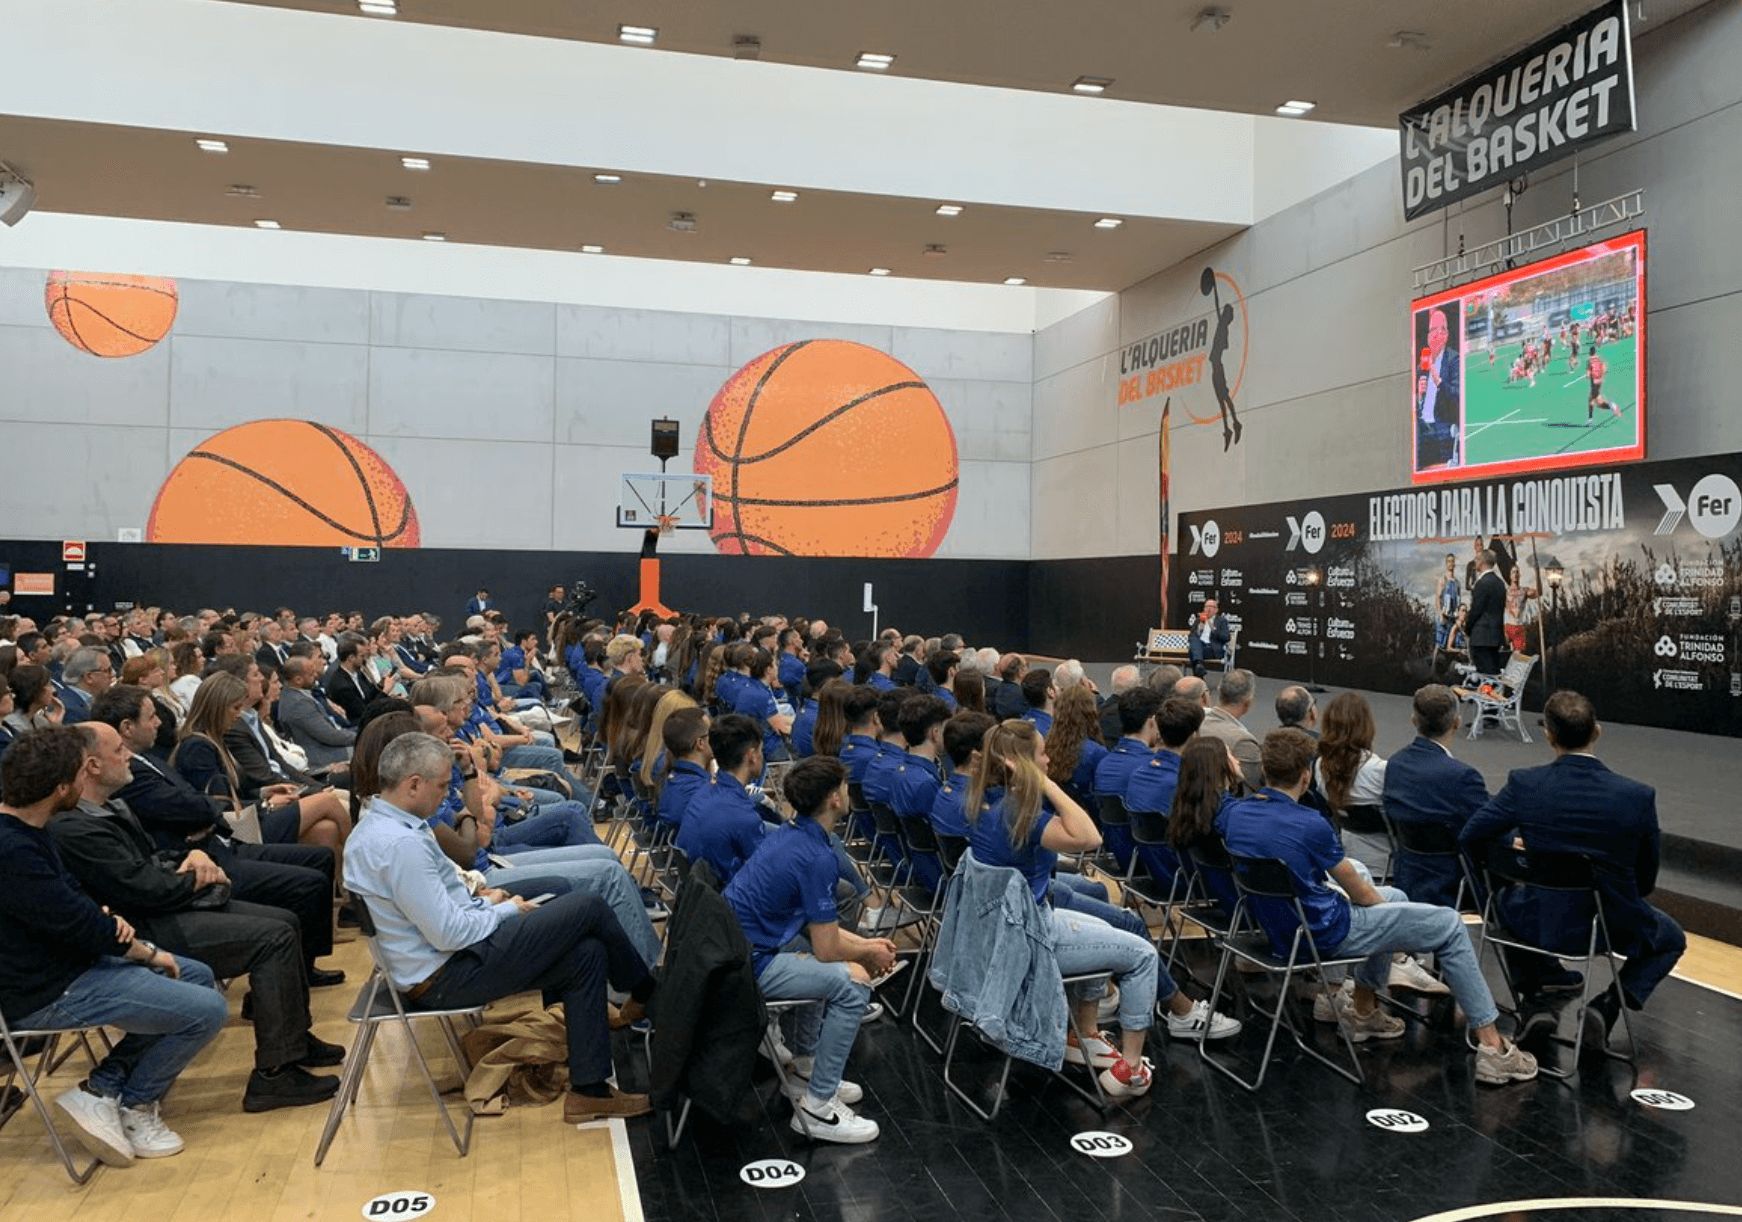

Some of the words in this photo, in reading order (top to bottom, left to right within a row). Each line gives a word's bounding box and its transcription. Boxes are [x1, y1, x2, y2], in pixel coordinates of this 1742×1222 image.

[1406, 16, 1620, 160] L'ALQUERIA
[1406, 152, 1459, 209] DEL
[1467, 74, 1619, 183] BASKET
[1120, 318, 1209, 375] L'ALQUERIA
[1117, 373, 1143, 407] DEL
[1146, 352, 1208, 396] BASKET
[1369, 490, 1437, 542] ELEGIDOS
[1441, 486, 1482, 537] PARA
[1486, 484, 1508, 535] LA
[1511, 472, 1626, 537] CONQUISTA
[1697, 494, 1732, 517] Fer
[1204, 532, 1217, 545] Fer
[1223, 530, 1243, 545] 2024
[1305, 524, 1321, 539] Fer
[1330, 522, 1356, 539] 2024
[1680, 567, 1724, 578] TRINIDAD
[1680, 577, 1724, 587] ALFONSO
[1680, 641, 1725, 653] TRINIDAD
[1680, 651, 1725, 663] ALFONSO
[1370, 1112, 1423, 1127] D02
[1074, 1135, 1127, 1151] D03
[745, 1164, 800, 1181] D04
[369, 1196, 430, 1216] D05
